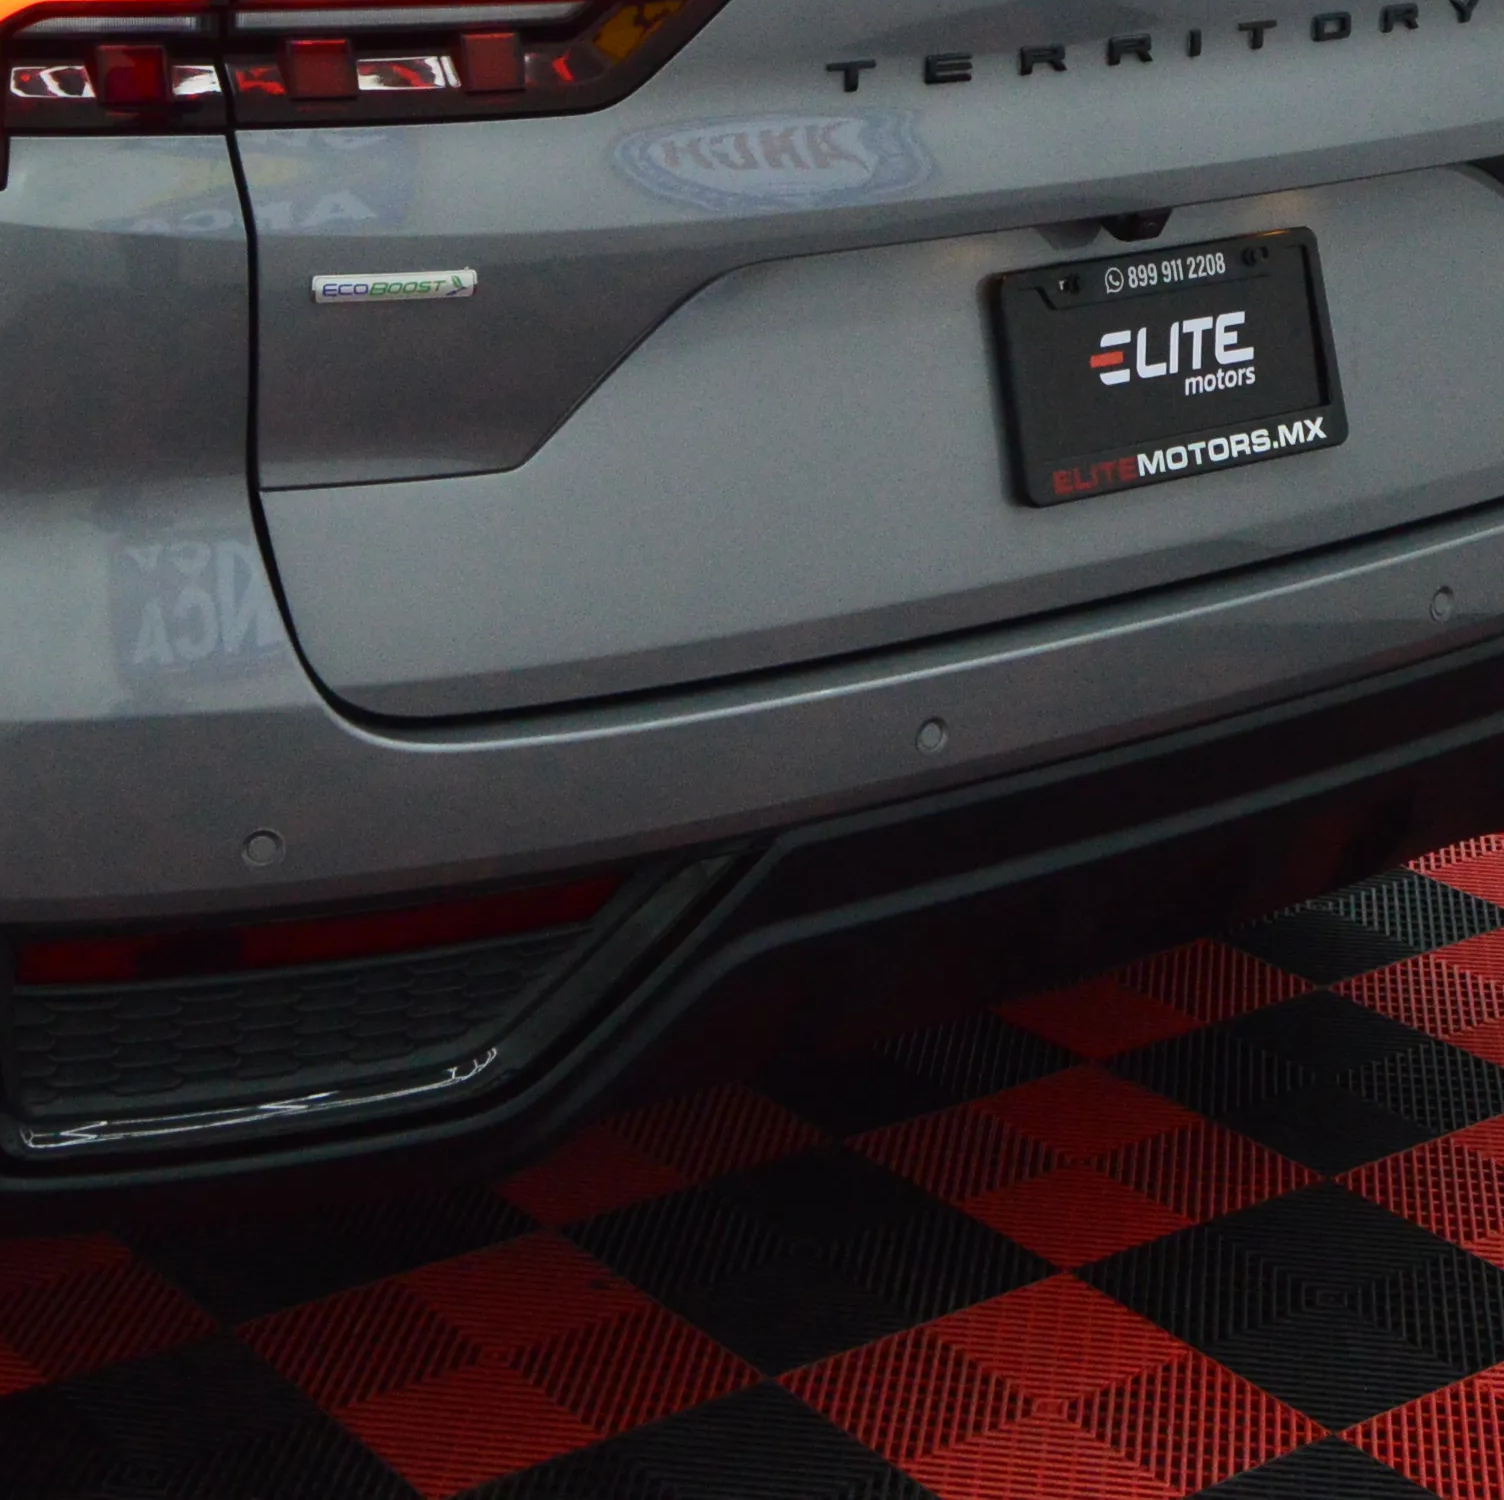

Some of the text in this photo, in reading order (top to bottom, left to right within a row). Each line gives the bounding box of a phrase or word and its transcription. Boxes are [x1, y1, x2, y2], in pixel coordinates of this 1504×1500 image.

[322, 279, 446, 297] ECOBOOST
[1127, 252, 1226, 289] 899 911 2208
[1090, 310, 1254, 386] ELITE
[1184, 365, 1256, 396] motors
[1052, 416, 1327, 495] ELITEMOTORS.MX
